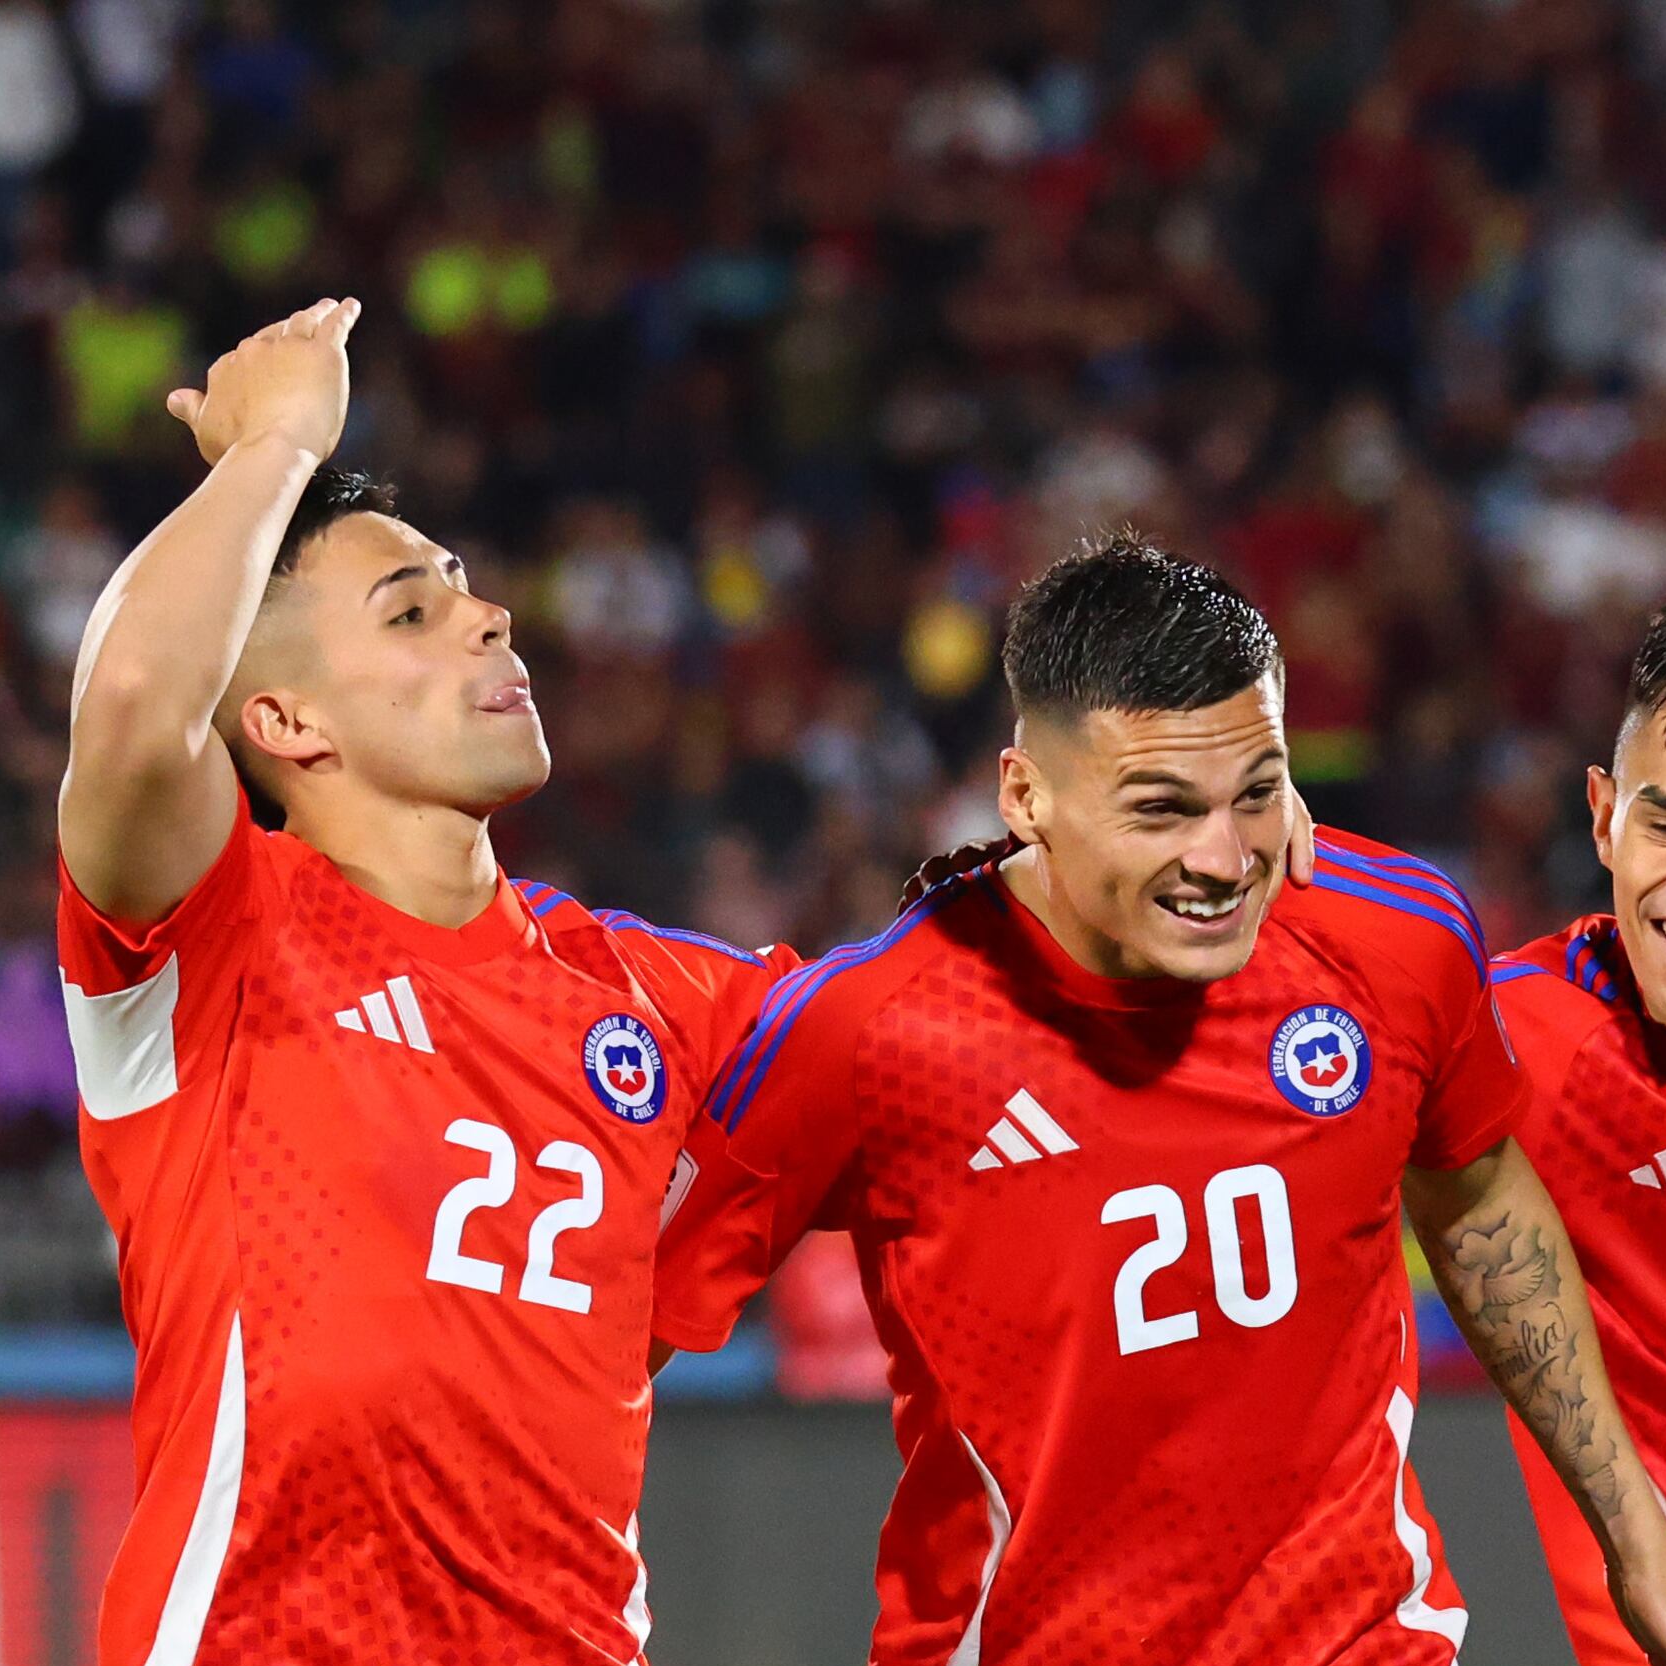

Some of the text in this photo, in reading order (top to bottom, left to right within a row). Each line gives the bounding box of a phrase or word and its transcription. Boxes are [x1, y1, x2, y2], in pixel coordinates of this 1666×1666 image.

[584, 1016, 662, 1072] FEDERACION DE FUTBOL
[1272, 1008, 1365, 1078] FEDERACION DE FUTBOL
[616, 1102, 655, 1119] DE CHILE
[1314, 1084, 1361, 1113] DE CHILE
[425, 1117, 604, 1315] 22
[1100, 1163, 1299, 1357] 20
